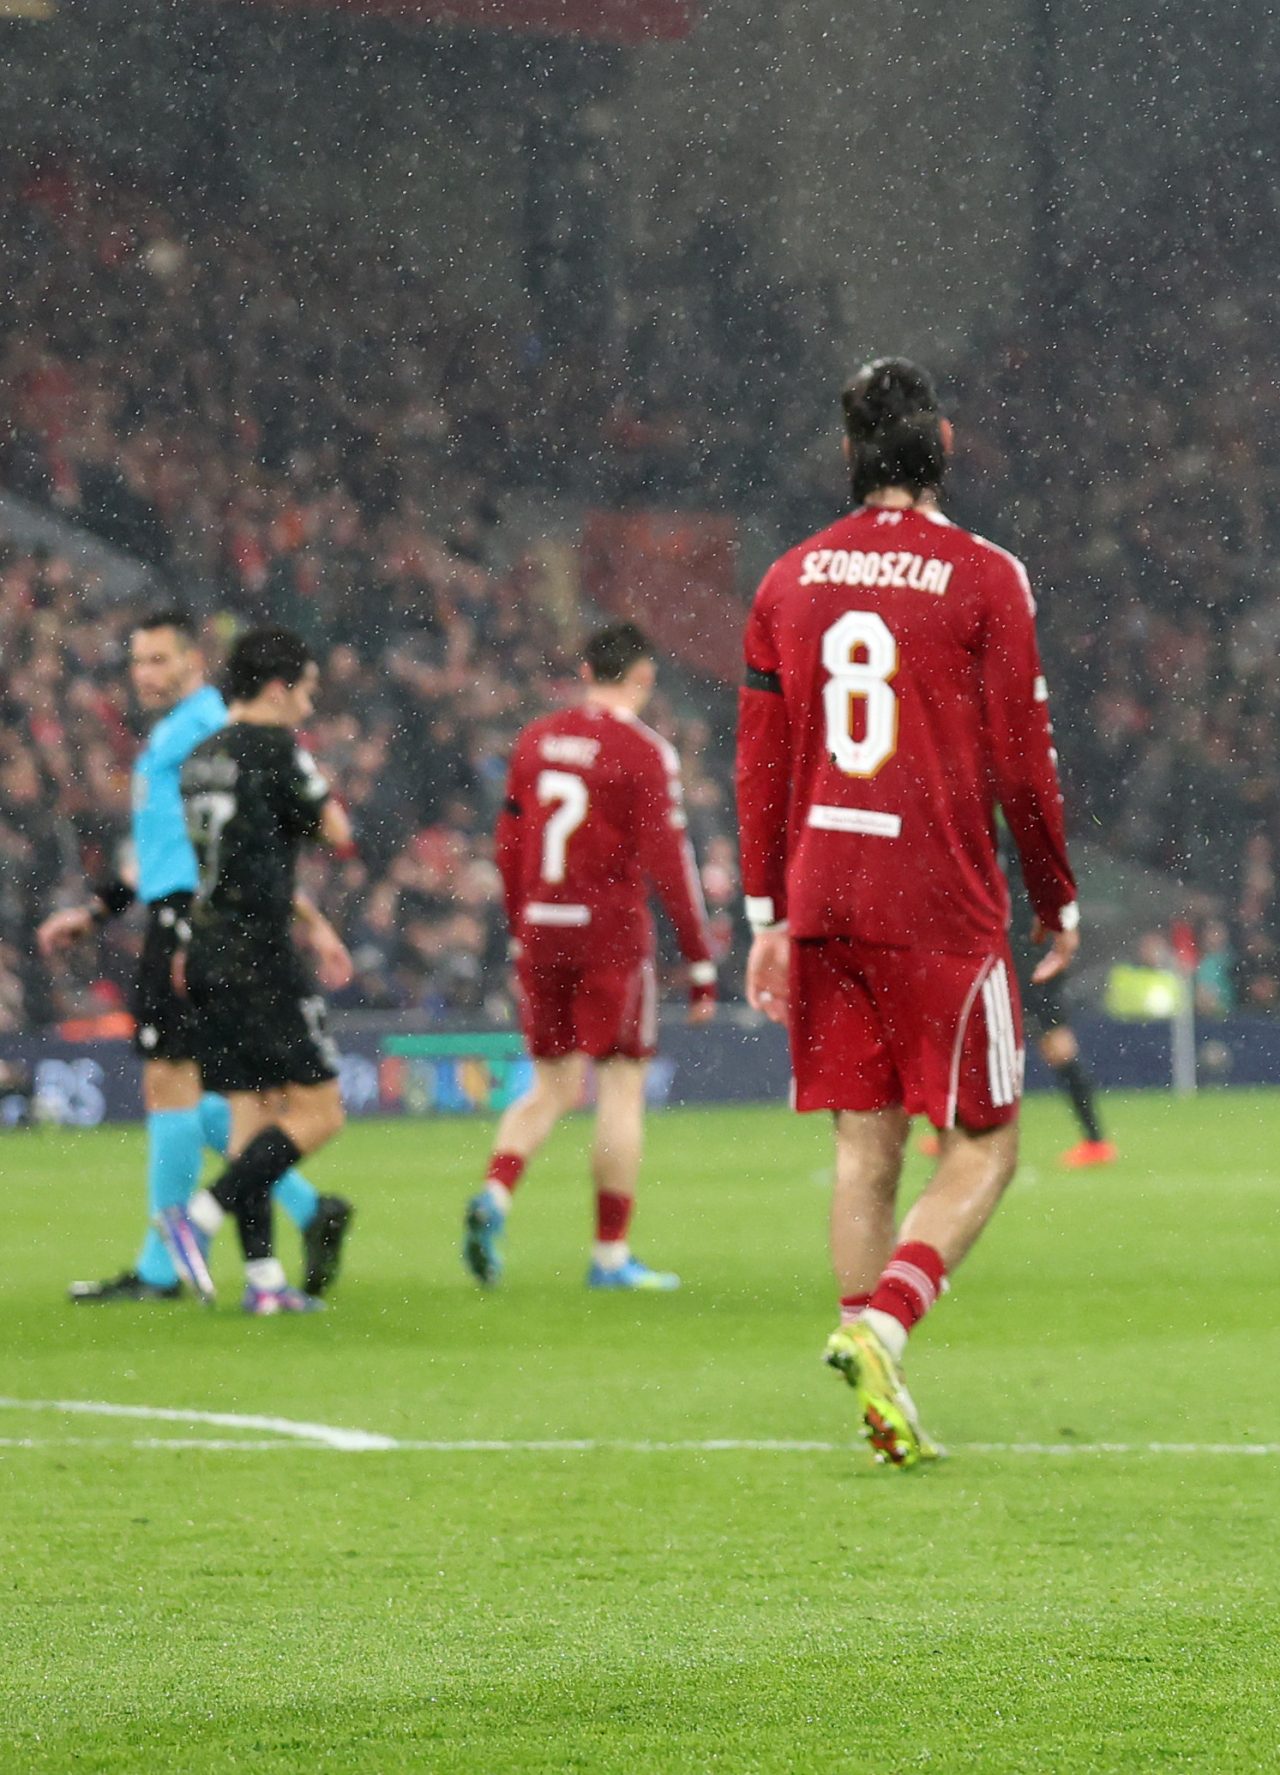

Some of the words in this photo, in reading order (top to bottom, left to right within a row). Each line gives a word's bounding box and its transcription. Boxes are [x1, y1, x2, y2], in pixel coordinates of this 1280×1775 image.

[798, 549, 954, 596] SZOBOSZLAI
[821, 609, 900, 779] 8
[537, 769, 590, 884] 7
